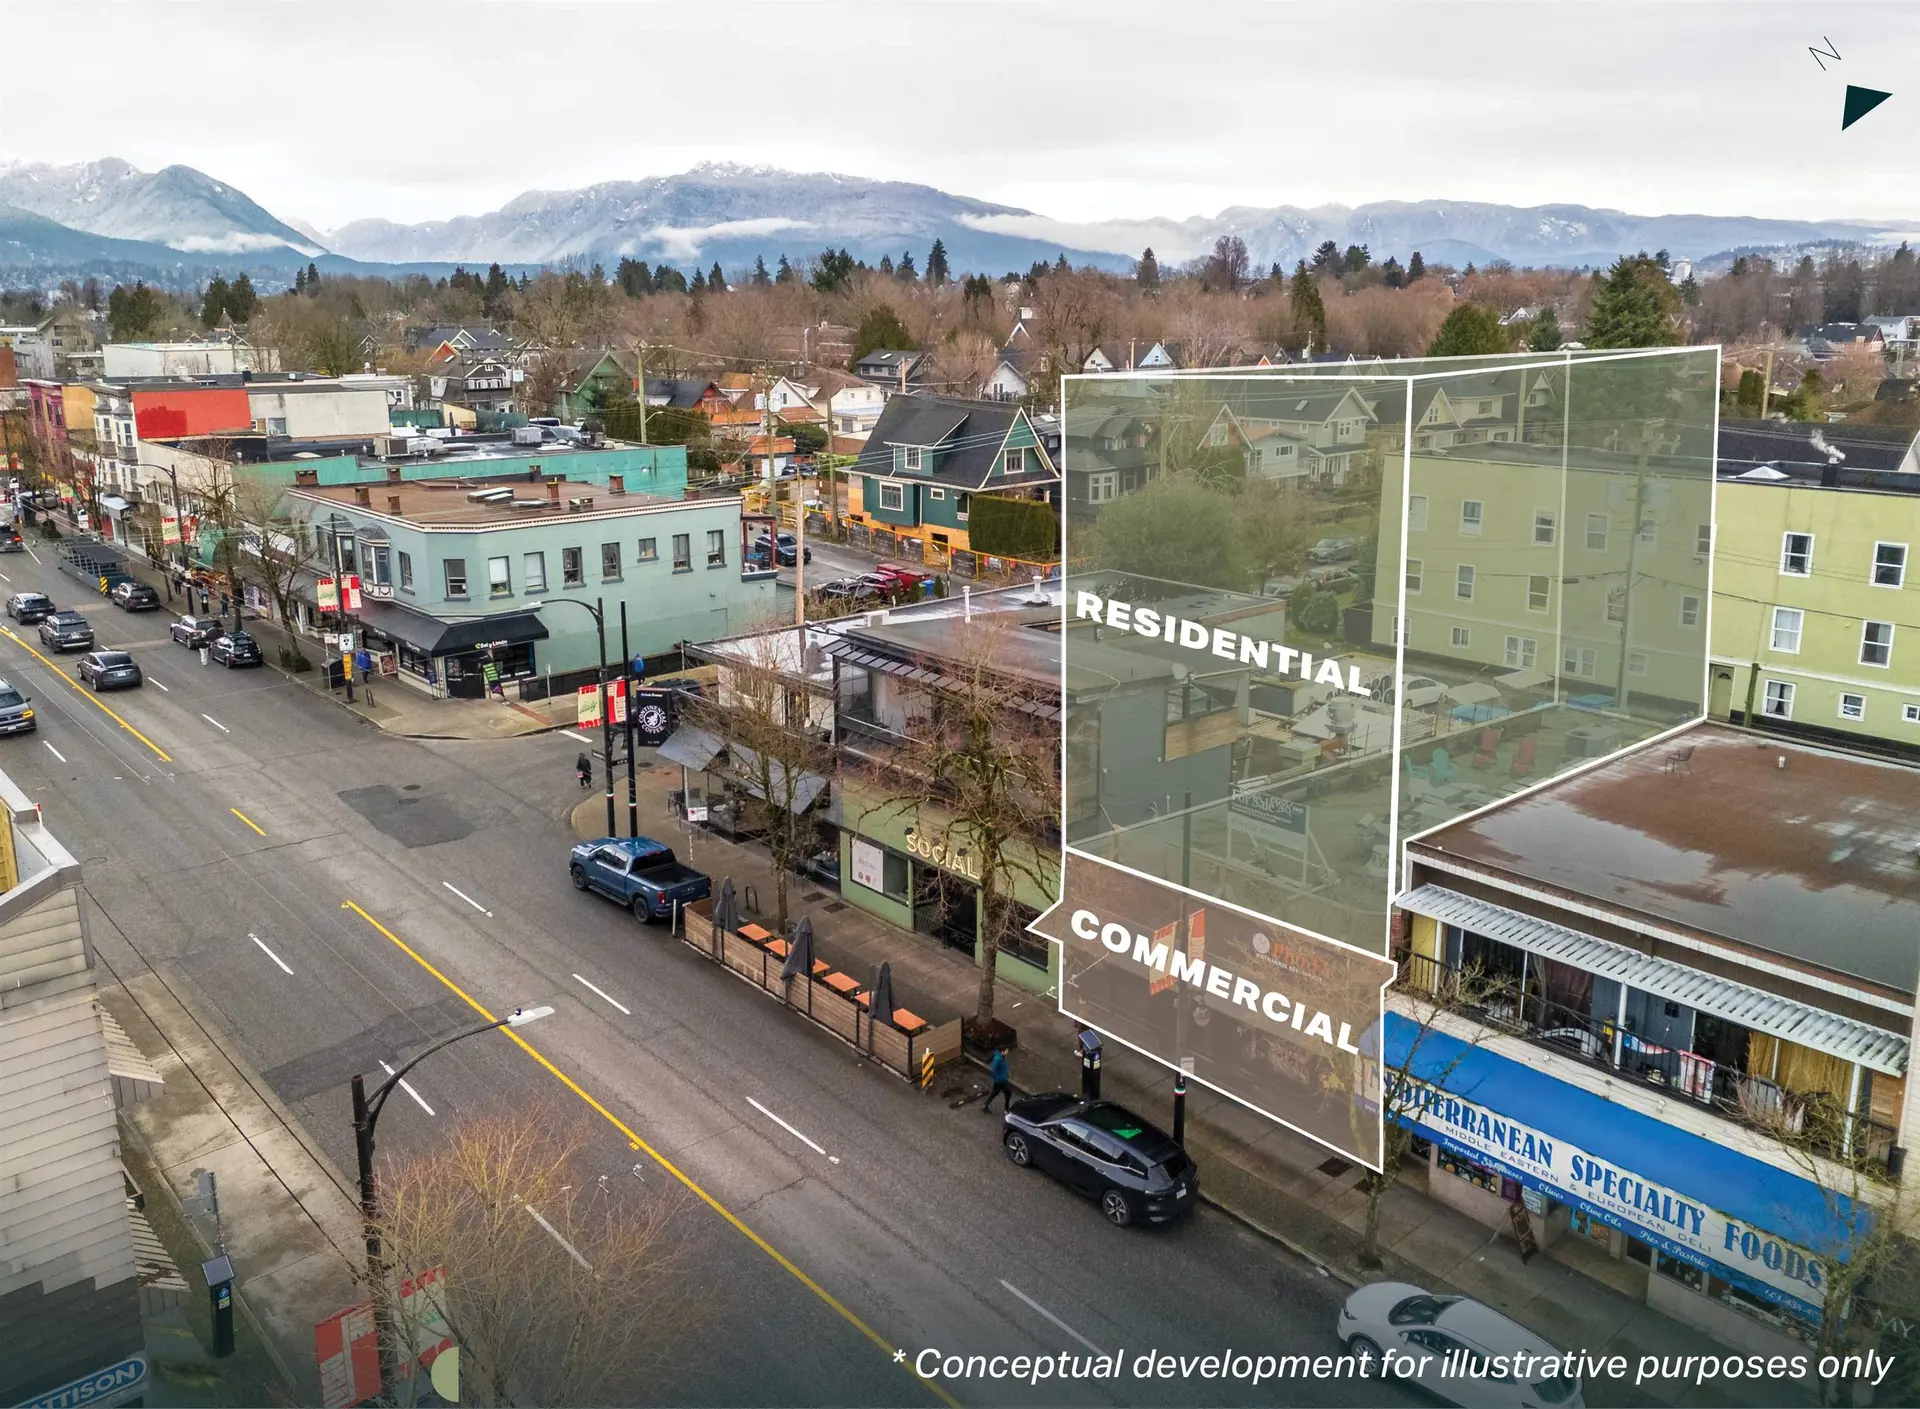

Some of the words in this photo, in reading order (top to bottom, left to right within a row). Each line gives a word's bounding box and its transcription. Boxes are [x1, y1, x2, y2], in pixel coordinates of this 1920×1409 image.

[638, 705, 668, 724] CONTINENTAL
[641, 722, 665, 735] COFFEE
[906, 833, 980, 880] SOCIAL
[1442, 1137, 1479, 1160] Imported
[1538, 1182, 1564, 1200] Olives
[1579, 1201, 1602, 1219] Olive
[1604, 1212, 1623, 1228] Oils
[1639, 1229, 1659, 1245] Pies
[1661, 1241, 1671, 1251] &
[1446, 1125, 1492, 1153] MIDDLE
[1500, 1149, 1559, 1183] EASTERN
[1568, 1183, 1577, 1193] &
[1587, 1191, 1666, 1232] EUROPEAN
[1678, 1232, 1711, 1253] DELI
[1570, 1154, 1706, 1237] SPECIALTY
[1724, 1222, 1823, 1290] FOODS
